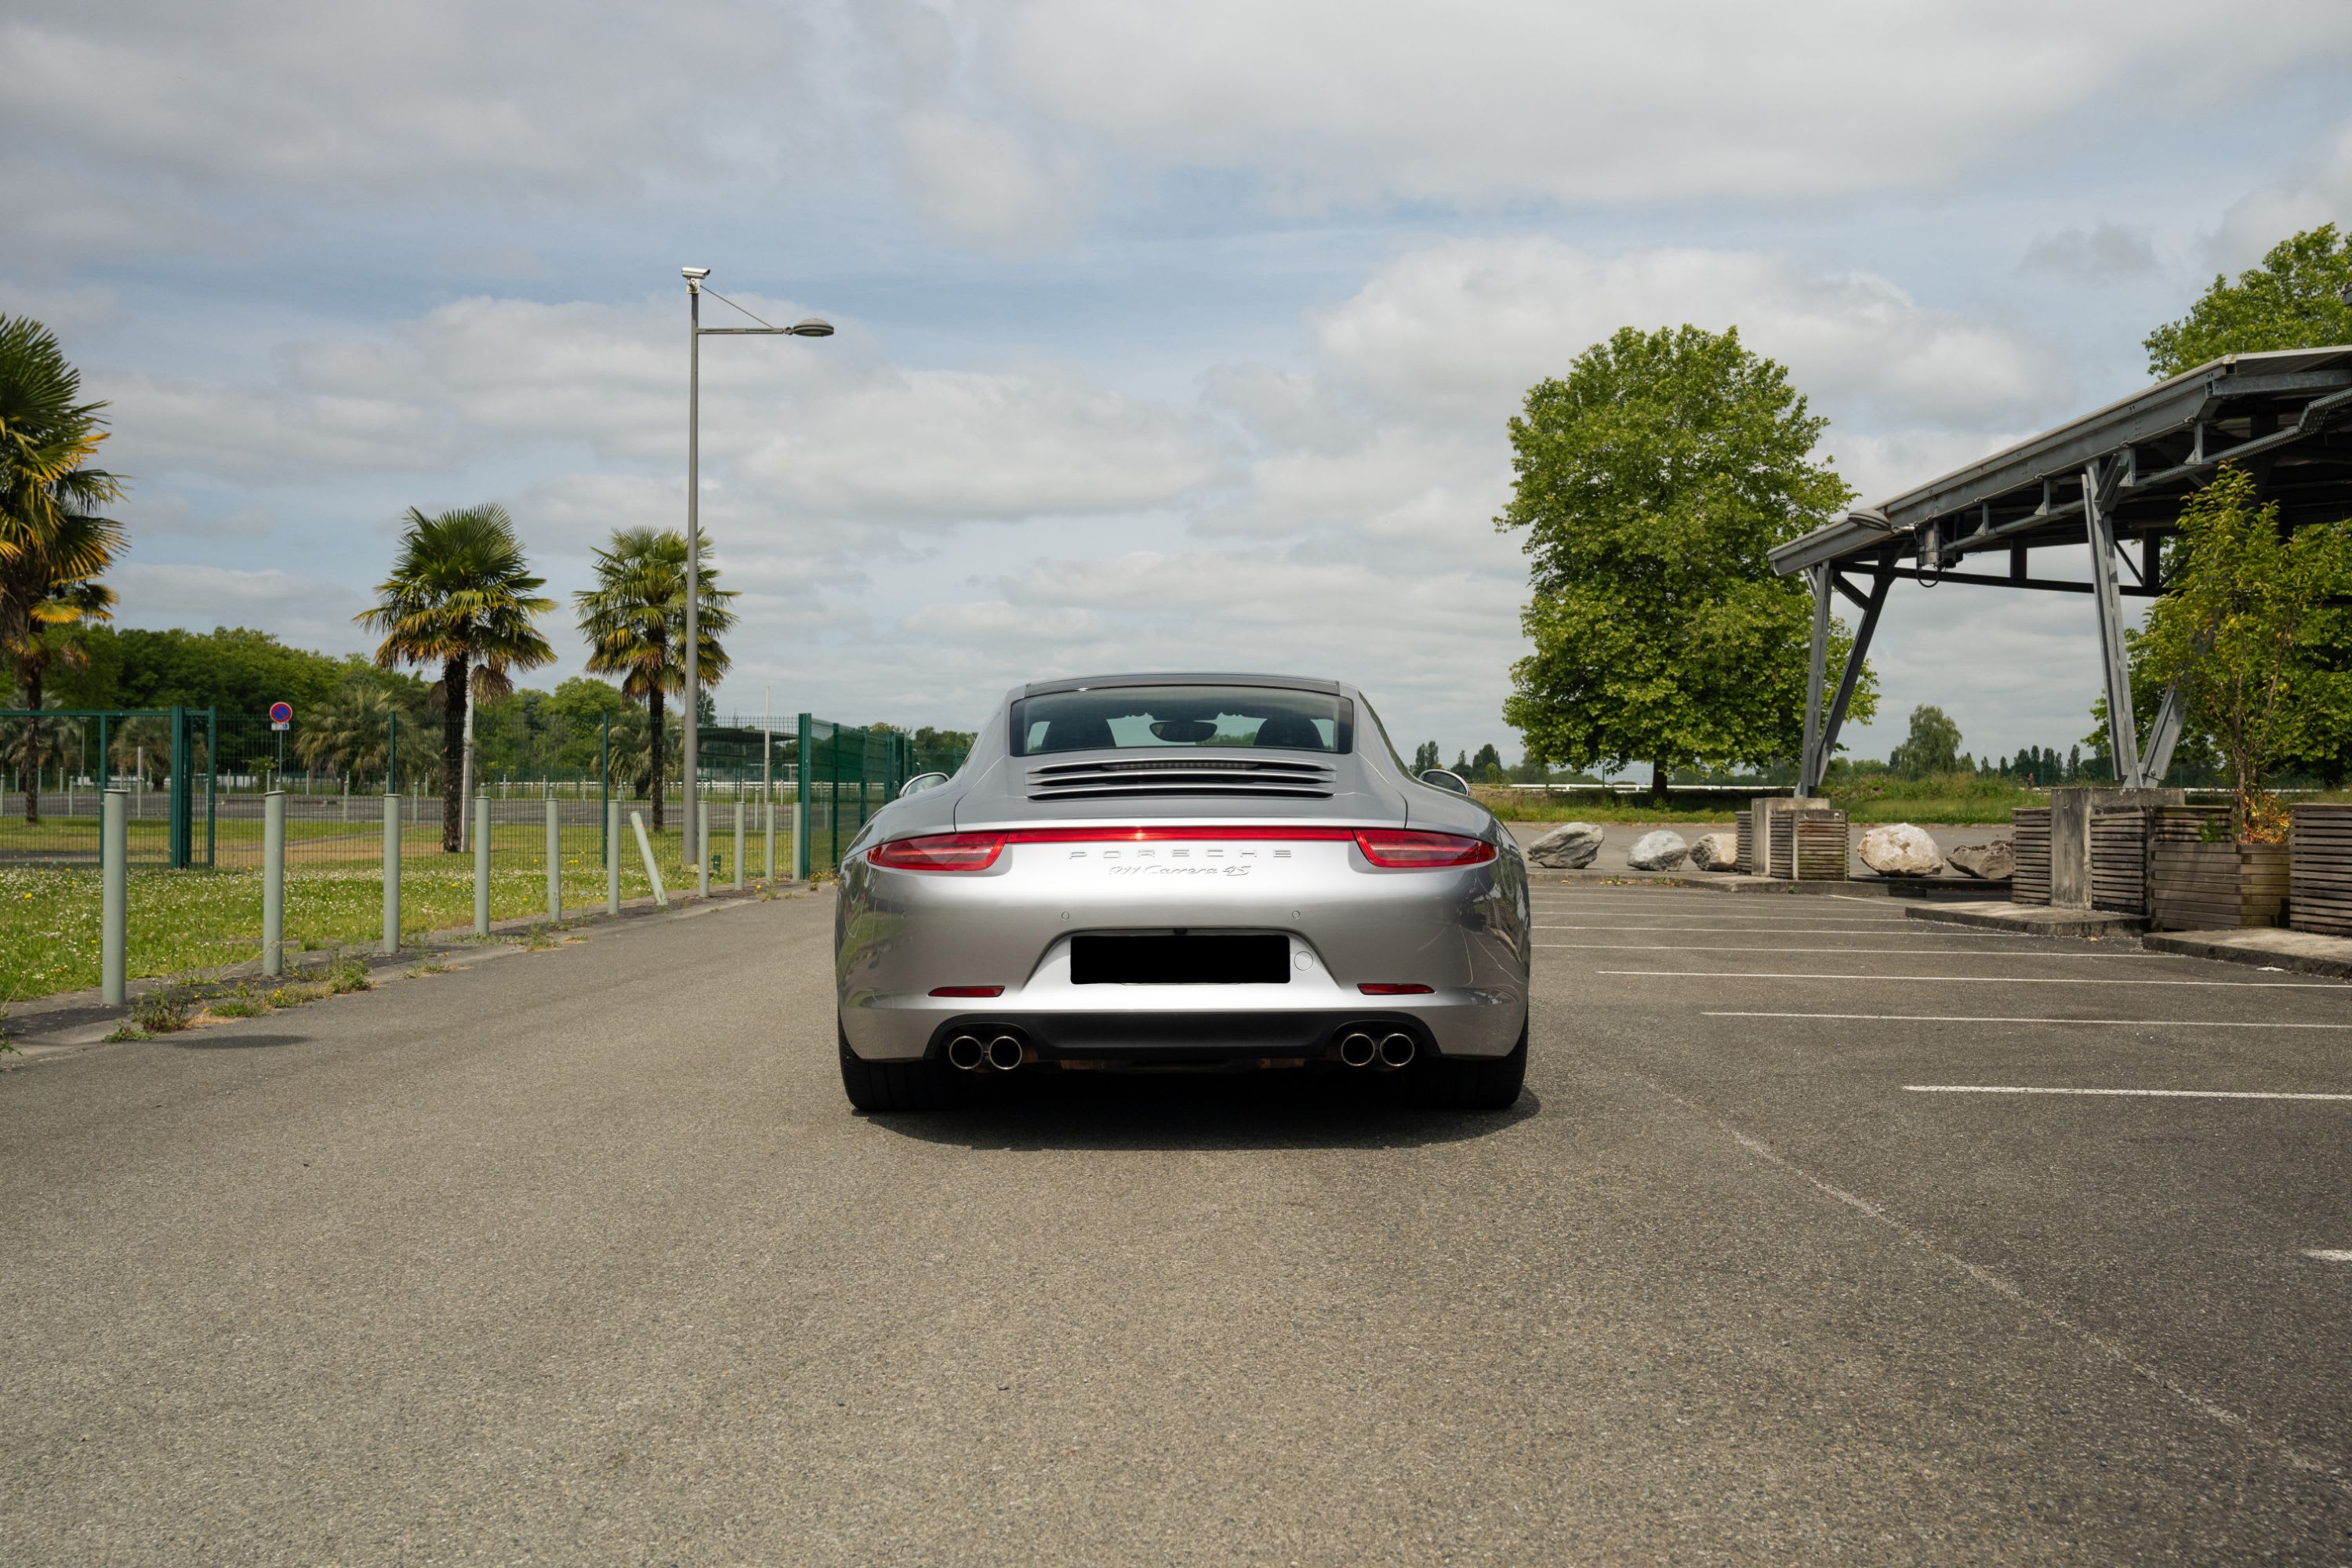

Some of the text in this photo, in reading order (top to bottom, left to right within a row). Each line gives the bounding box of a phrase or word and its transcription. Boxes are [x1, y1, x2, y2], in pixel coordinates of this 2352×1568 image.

[1069, 849, 1292, 859] PORSCHE
[1108, 865, 1252, 877] 911 Carrera 4S
